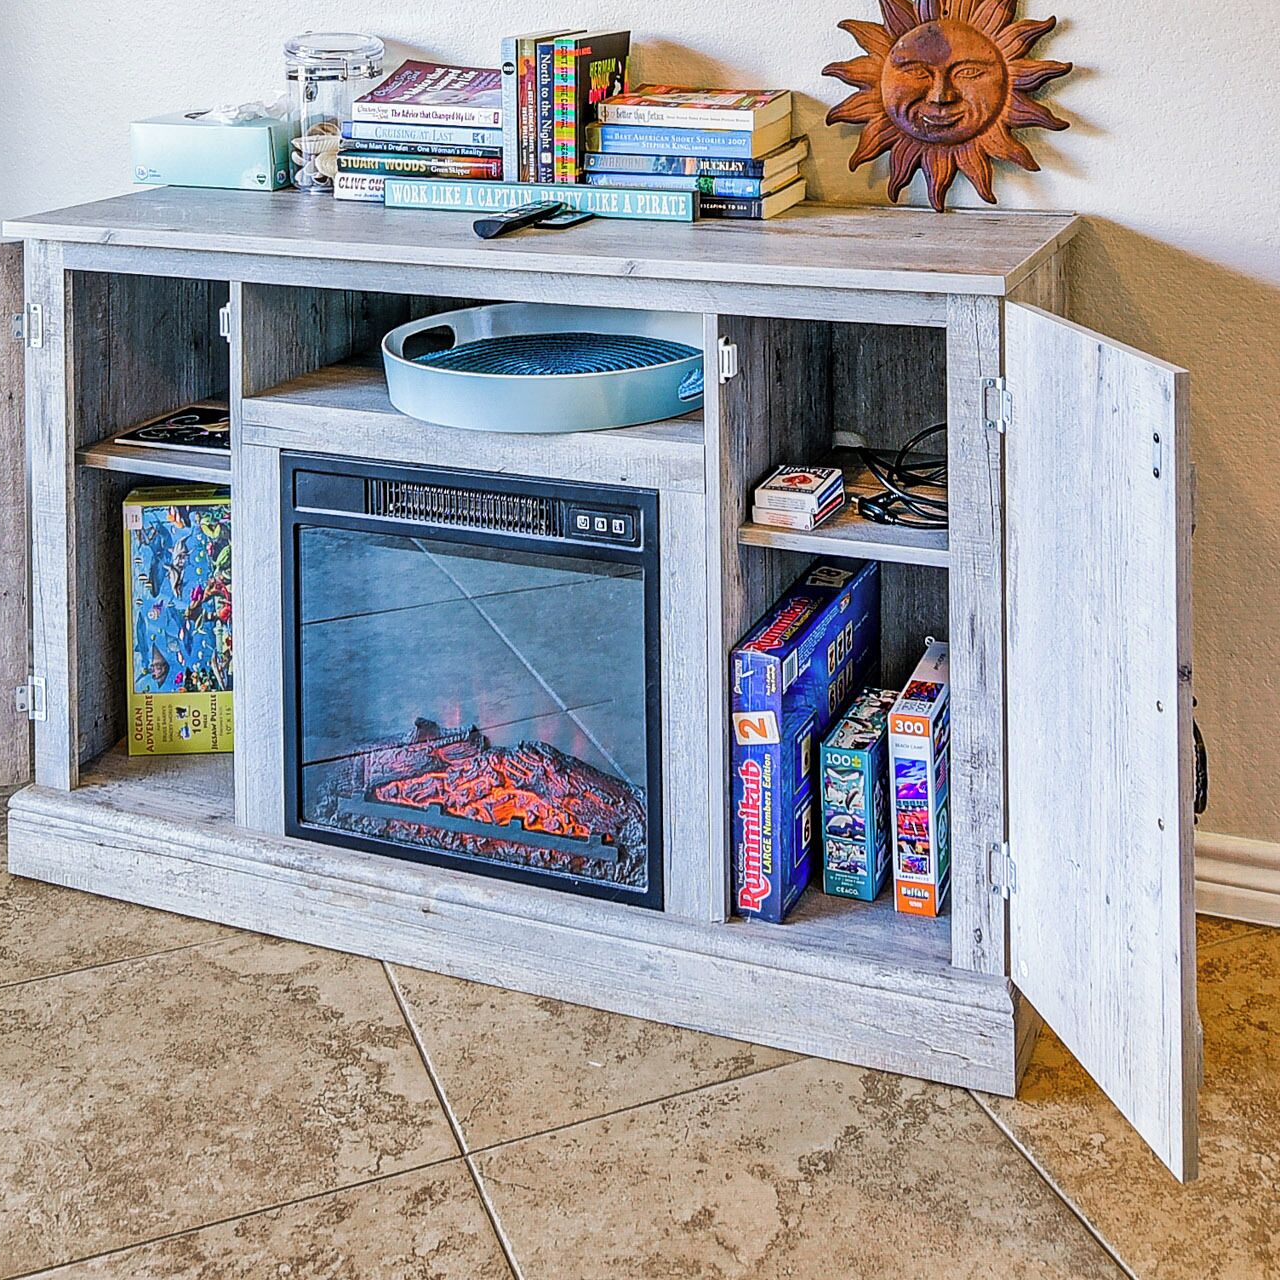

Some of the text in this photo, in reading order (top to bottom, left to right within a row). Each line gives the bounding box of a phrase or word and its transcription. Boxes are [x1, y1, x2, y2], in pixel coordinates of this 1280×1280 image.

[589, 58, 616, 78] HERMAN
[540, 54, 553, 148] North to the Night
[391, 109, 401, 117] The
[402, 110, 419, 118] Advice
[432, 111, 455, 121] Changed
[456, 113, 464, 122] My
[465, 113, 475, 121] Life
[374, 127, 454, 142] CRUISING AT LAST
[614, 133, 631, 142] BEST
[633, 134, 669, 142] AMERICAN
[671, 135, 694, 143] SHORT
[696, 136, 725, 144] STORIES
[727, 138, 746, 146] 2007
[355, 142, 367, 150] One
[368, 143, 387, 151] Man's
[431, 147, 459, 155] Woman's
[461, 148, 483, 156] Reality
[340, 157, 380, 169] STUART
[384, 159, 427, 172] WOODS
[700, 160, 744, 171] BUCKLEY
[339, 177, 367, 190] CLIVE
[392, 184, 429, 205] WORK
[432, 186, 462, 206] LIKE
[465, 187, 474, 206] A
[478, 188, 532, 208] CAPTAIN
[587, 193, 619, 212] LIKE
[623, 194, 633, 213] A
[637, 194, 687, 216] PIRATE
[134, 707, 144, 741] OCEAN
[146, 695, 154, 753] ADVENTURE
[192, 709, 201, 734] 100
[739, 718, 768, 739] 2
[895, 720, 924, 734] 300
[210, 723, 218, 750] JIGSAW
[826, 753, 851, 767] 100
[763, 754, 772, 873] LARGE Numbers Edition
[739, 760, 771, 911] Rummikub
[901, 887, 929, 897] Buffalo
